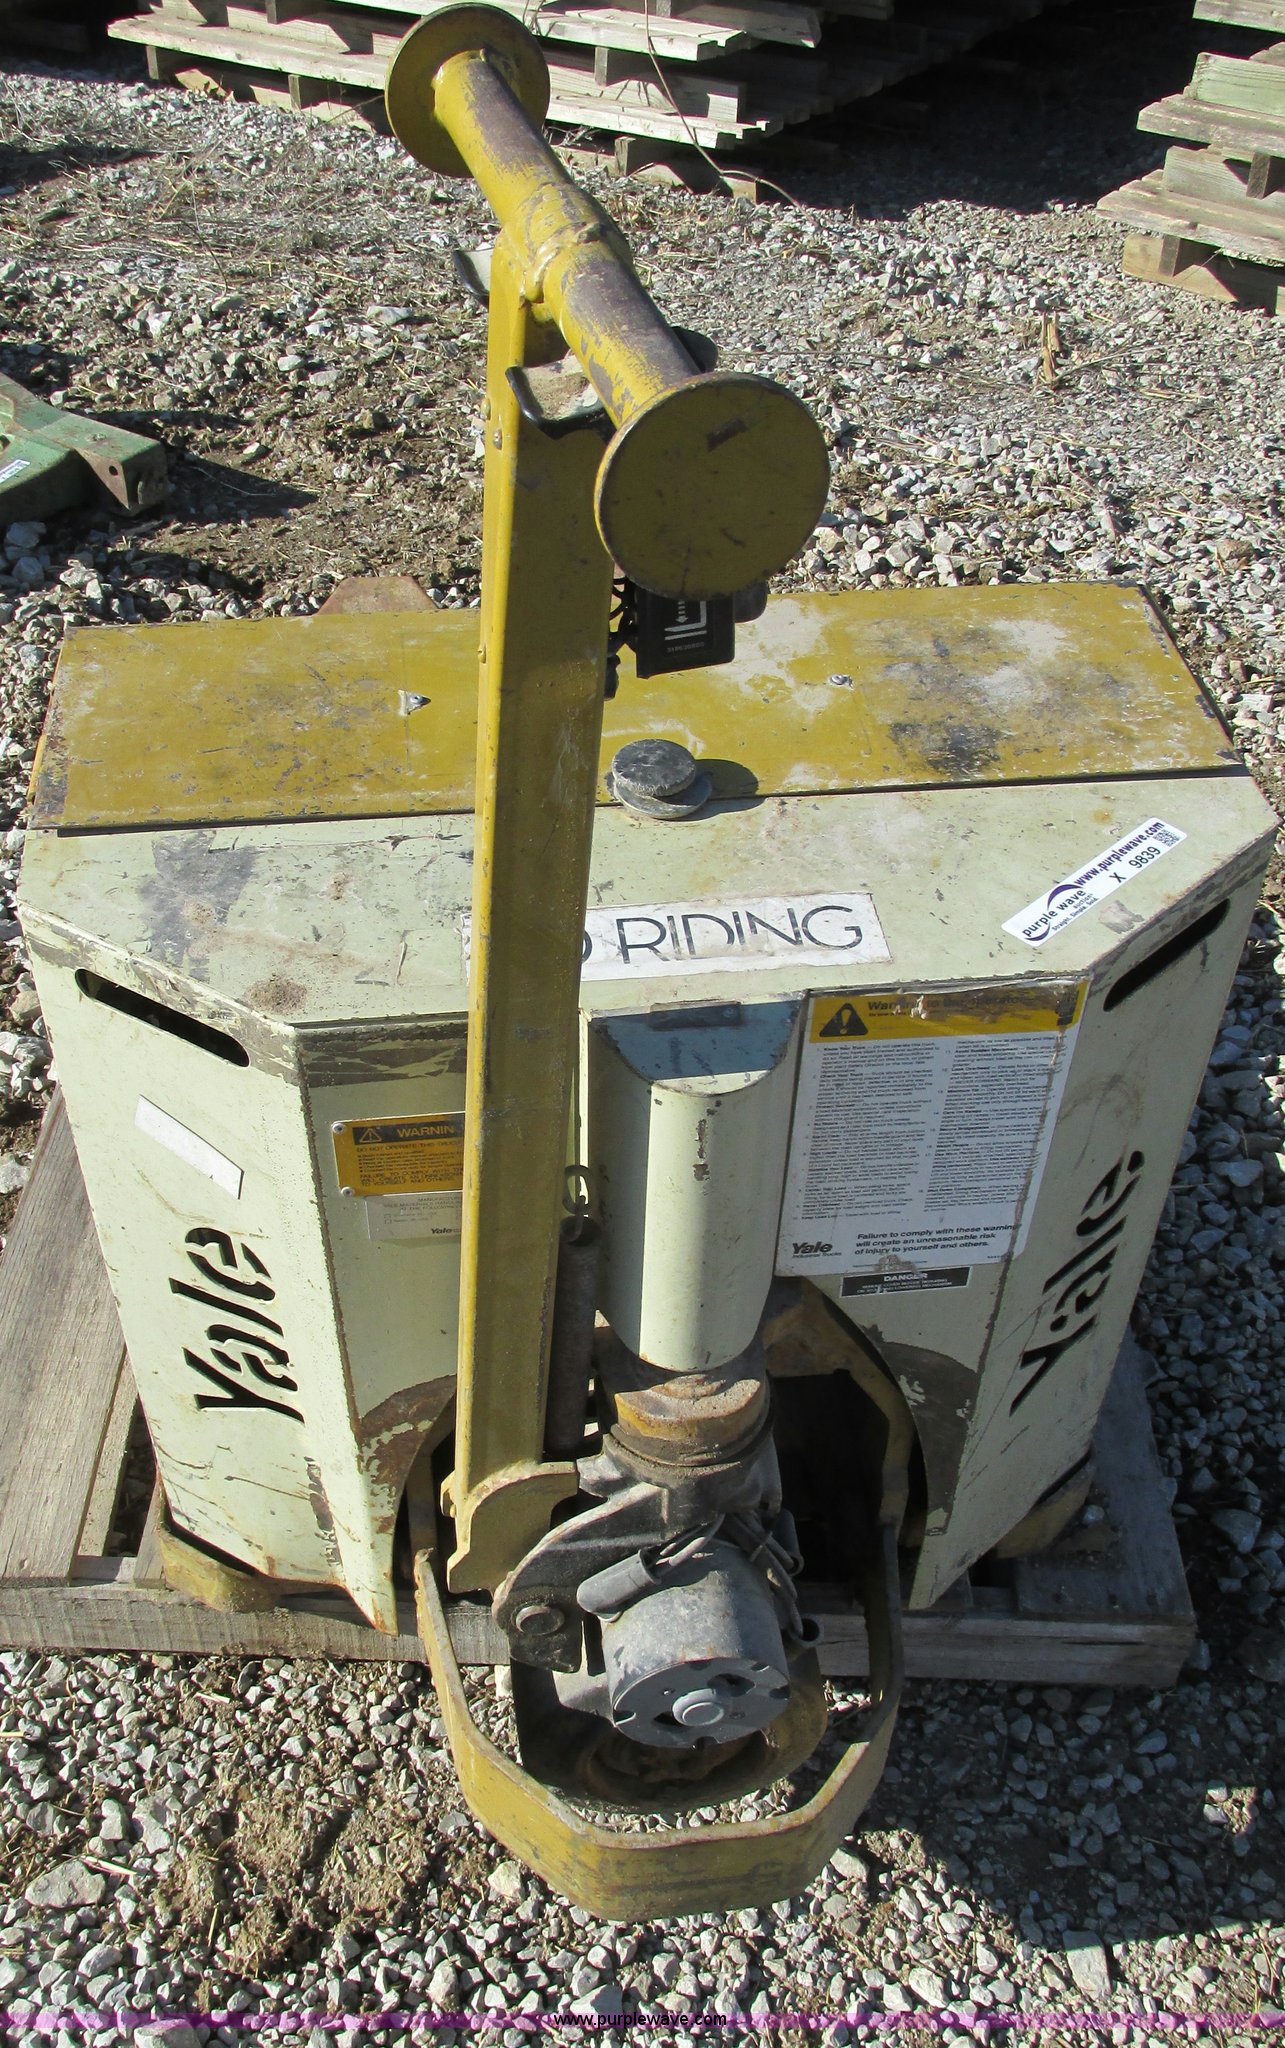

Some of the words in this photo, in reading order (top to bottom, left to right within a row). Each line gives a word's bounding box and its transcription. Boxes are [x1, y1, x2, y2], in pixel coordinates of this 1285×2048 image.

[1074, 821, 1165, 886] www.purplewave.com
[1109, 872, 1127, 884] X
[1128, 846, 1161, 869] 9839
[1022, 910, 1058, 937] purple
[1056, 890, 1086, 910] wave
[615, 905, 863, 964] RIDING
[397, 1125, 461, 1138] WARNIN
[792, 1241, 833, 1254] Yale
[855, 1248, 864, 1256] of
[865, 1247, 890, 1256] injury
[902, 1244, 939, 1253] yourself
[959, 1240, 990, 1248] others.
[872, 1240, 901, 1248] create
[917, 1234, 977, 1244] unreasonable
[935, 1227, 954, 1235] with
[1009, 1150, 1144, 1417] Yale
[168, 1227, 305, 1424] Yale
